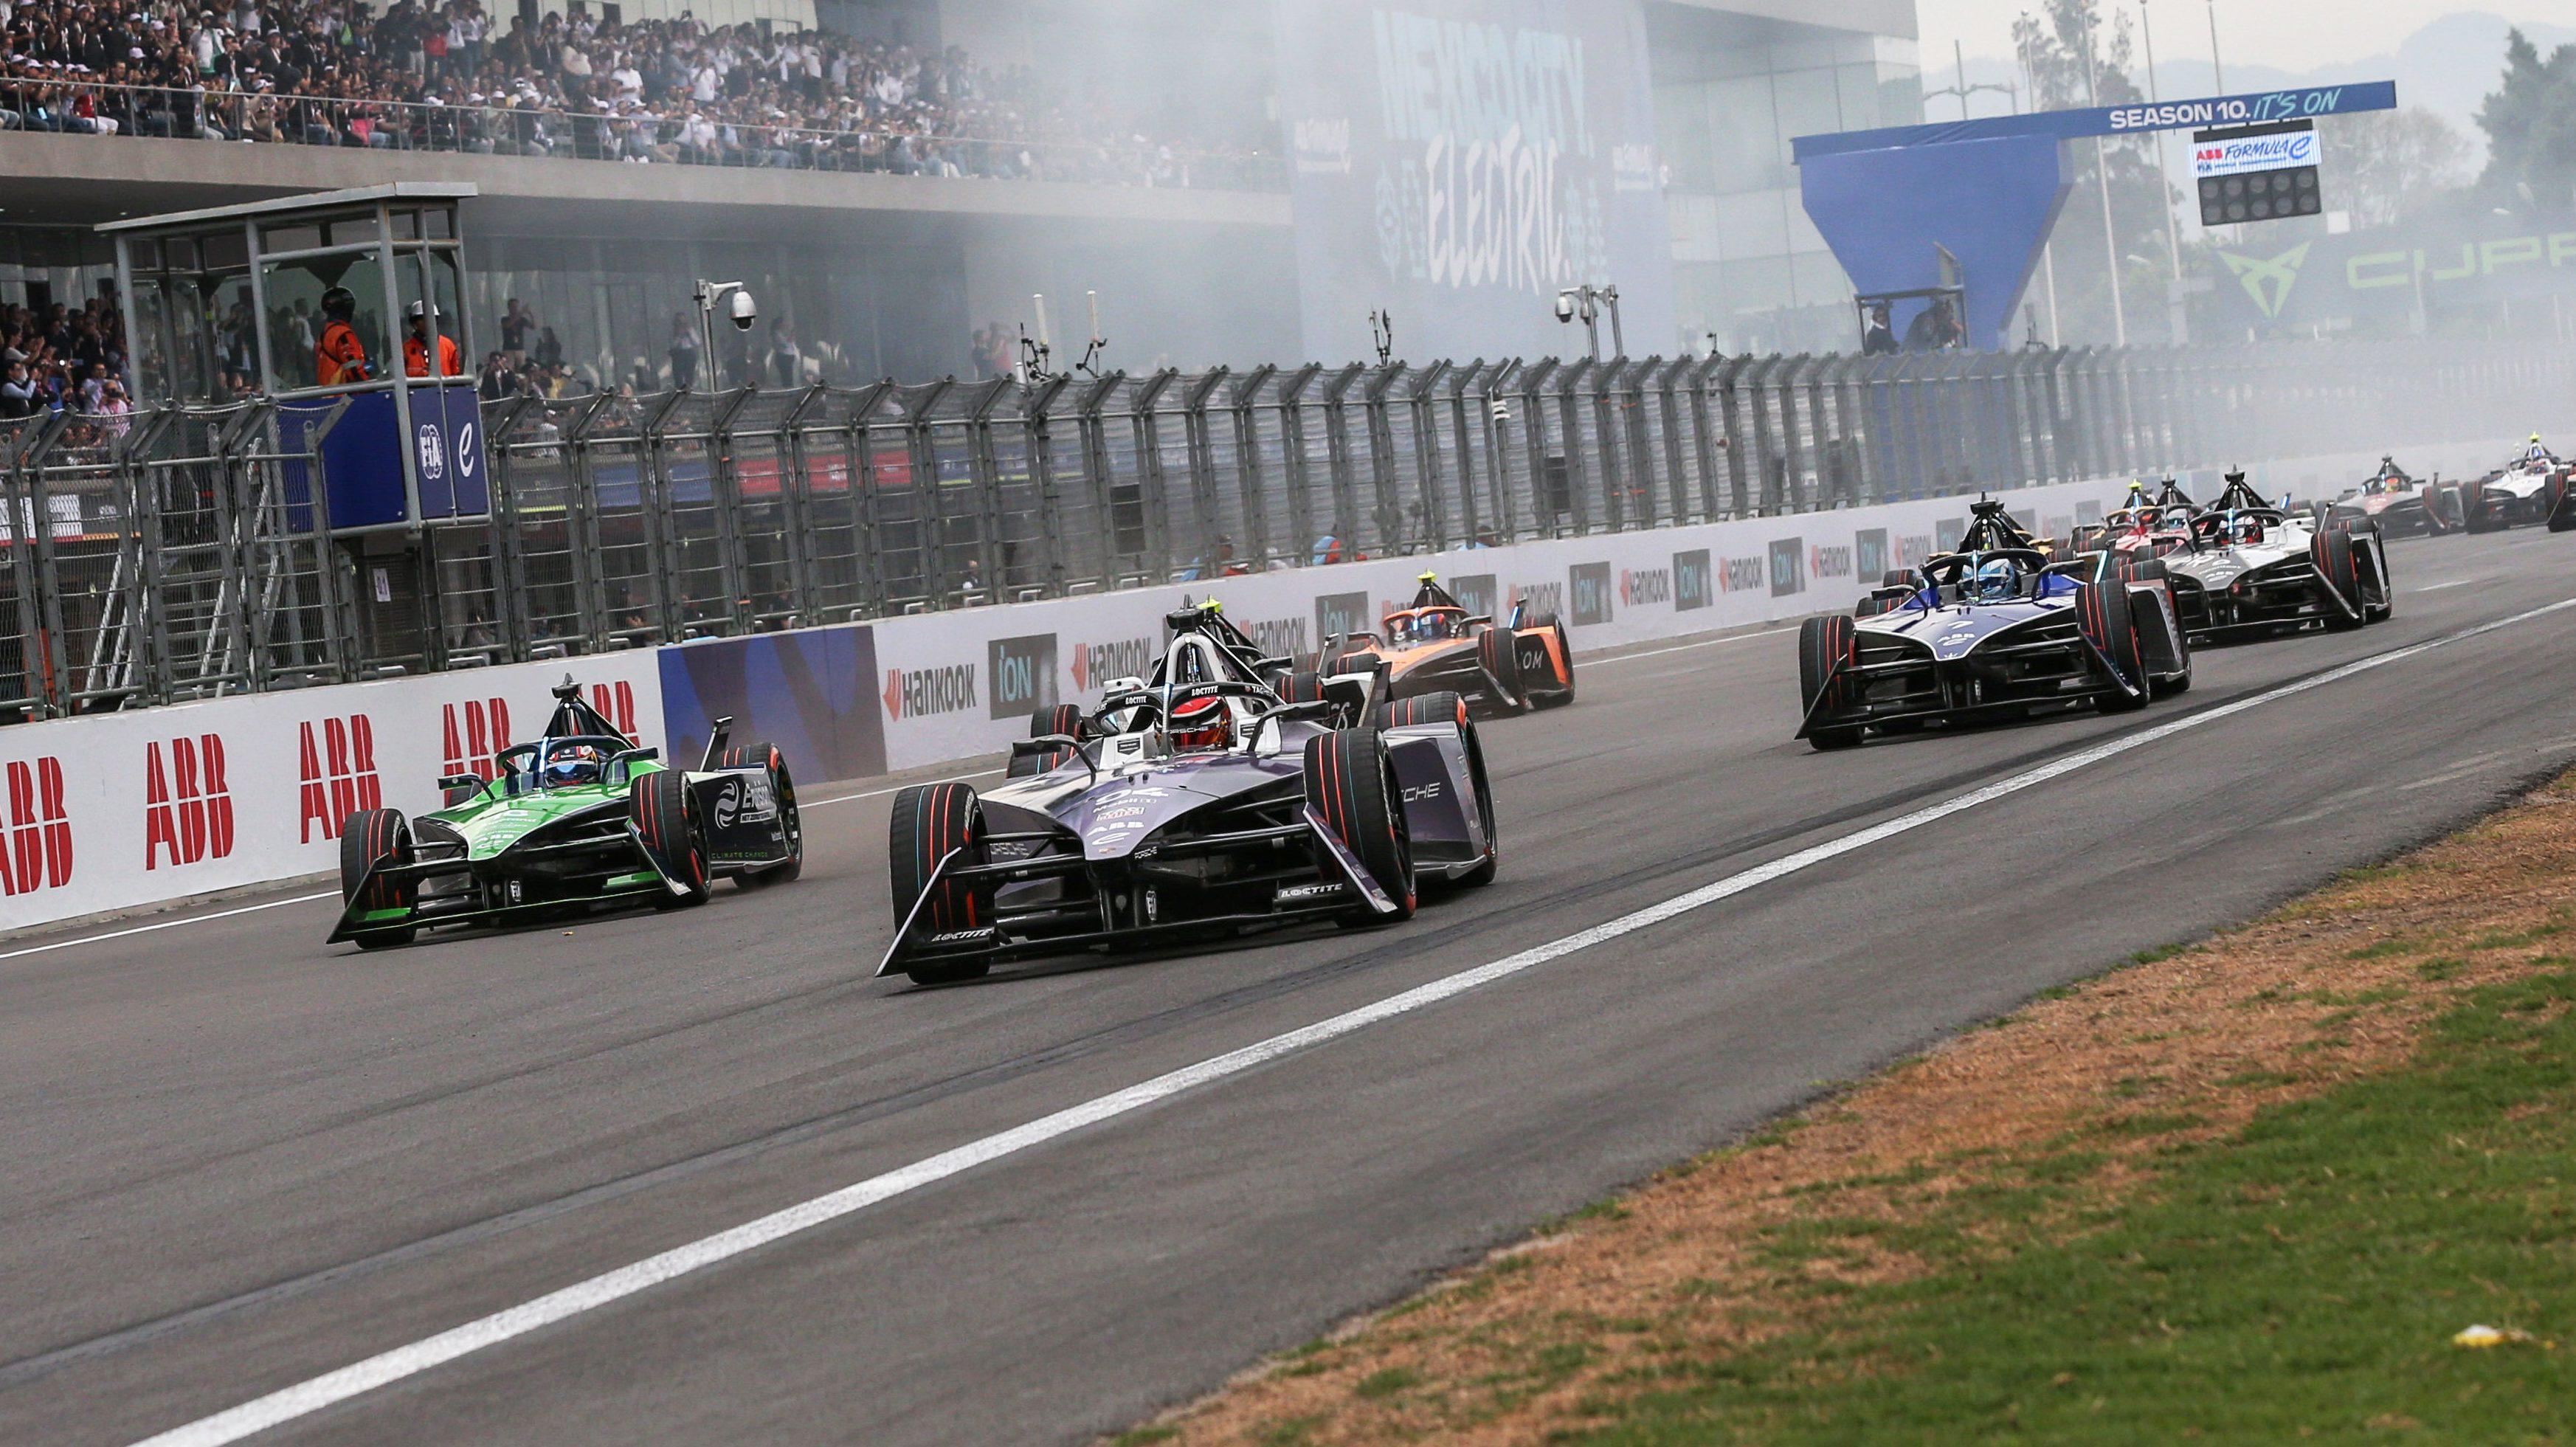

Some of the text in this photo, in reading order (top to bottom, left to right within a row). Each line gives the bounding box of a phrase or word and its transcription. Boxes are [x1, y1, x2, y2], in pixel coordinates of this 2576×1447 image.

[2109, 88, 2342, 129] SEASON 10. IT'S ON
[2196, 149, 2223, 160] ABB
[2225, 139, 2288, 160] FORMULA
[1521, 650, 1544, 669] OM
[1192, 685, 1218, 697] LOCTITE
[300, 714, 382, 844] ABB
[147, 733, 234, 871] ABB
[1401, 782, 1440, 803] CHE
[0, 756, 73, 896] BB
[1086, 821, 1144, 837] ABB
[1280, 883, 1343, 899] LOCTITE
[931, 928, 995, 942] LOCTITE
